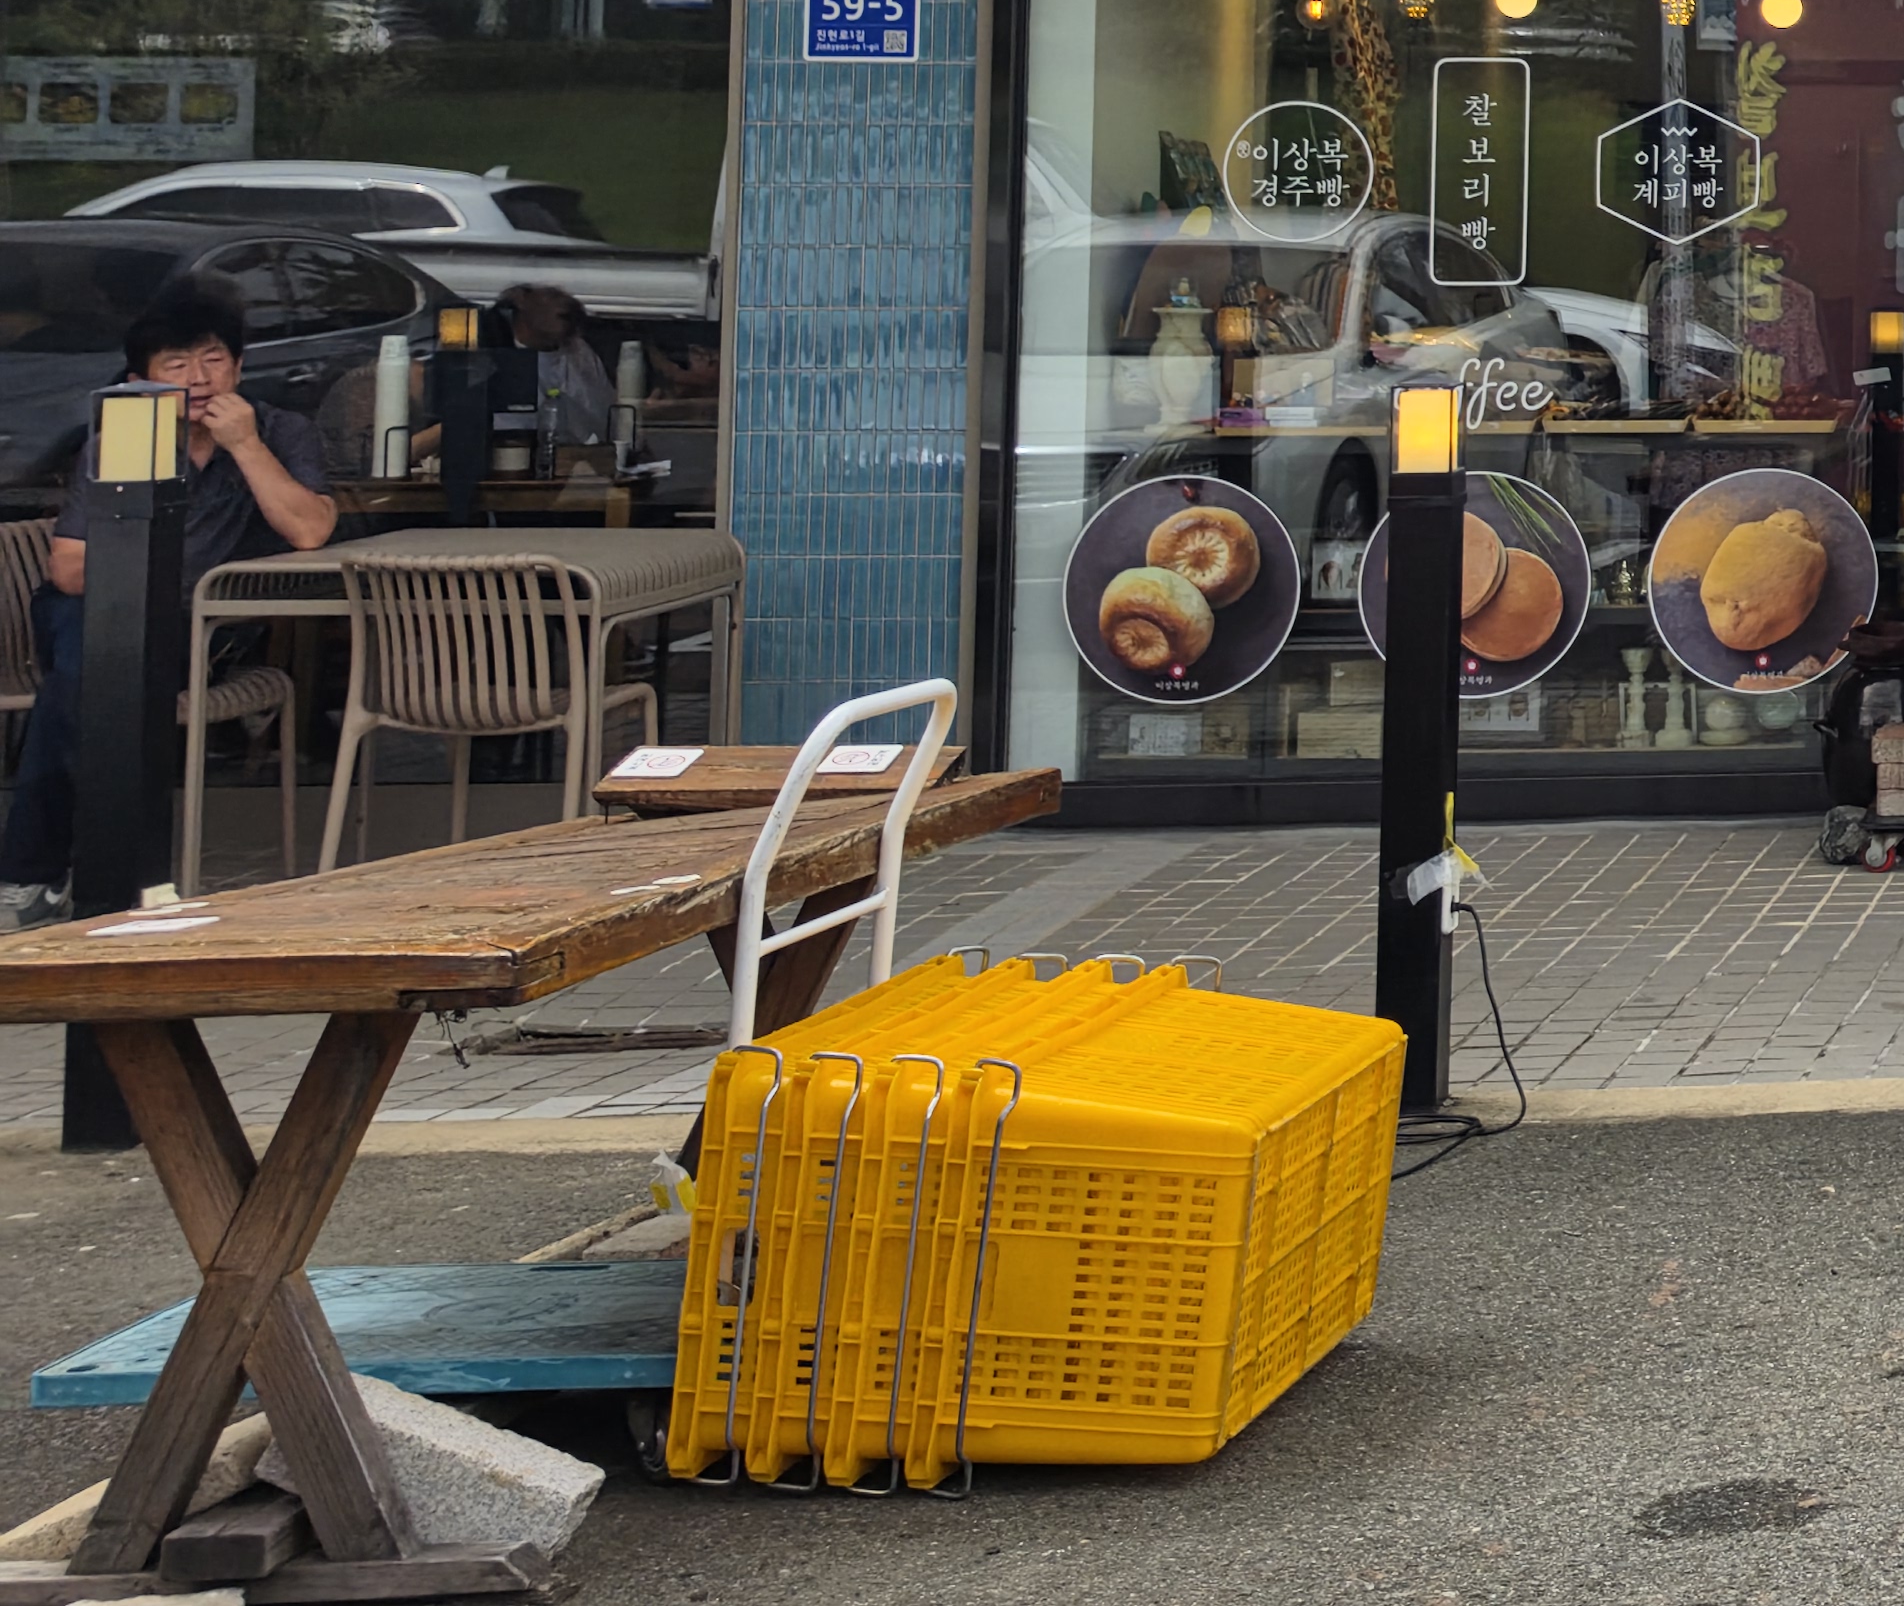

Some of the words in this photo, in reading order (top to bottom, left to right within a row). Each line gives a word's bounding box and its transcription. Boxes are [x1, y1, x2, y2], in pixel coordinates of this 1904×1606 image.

[1253, 137, 1349, 171] 이상복
[1634, 144, 1723, 175] 이상복
[1462, 93, 1498, 251] 찰보리빵
[1251, 174, 1350, 207] 경주빵
[1632, 178, 1724, 209] 계피빵
[1394, 357, 1554, 430] ffee
